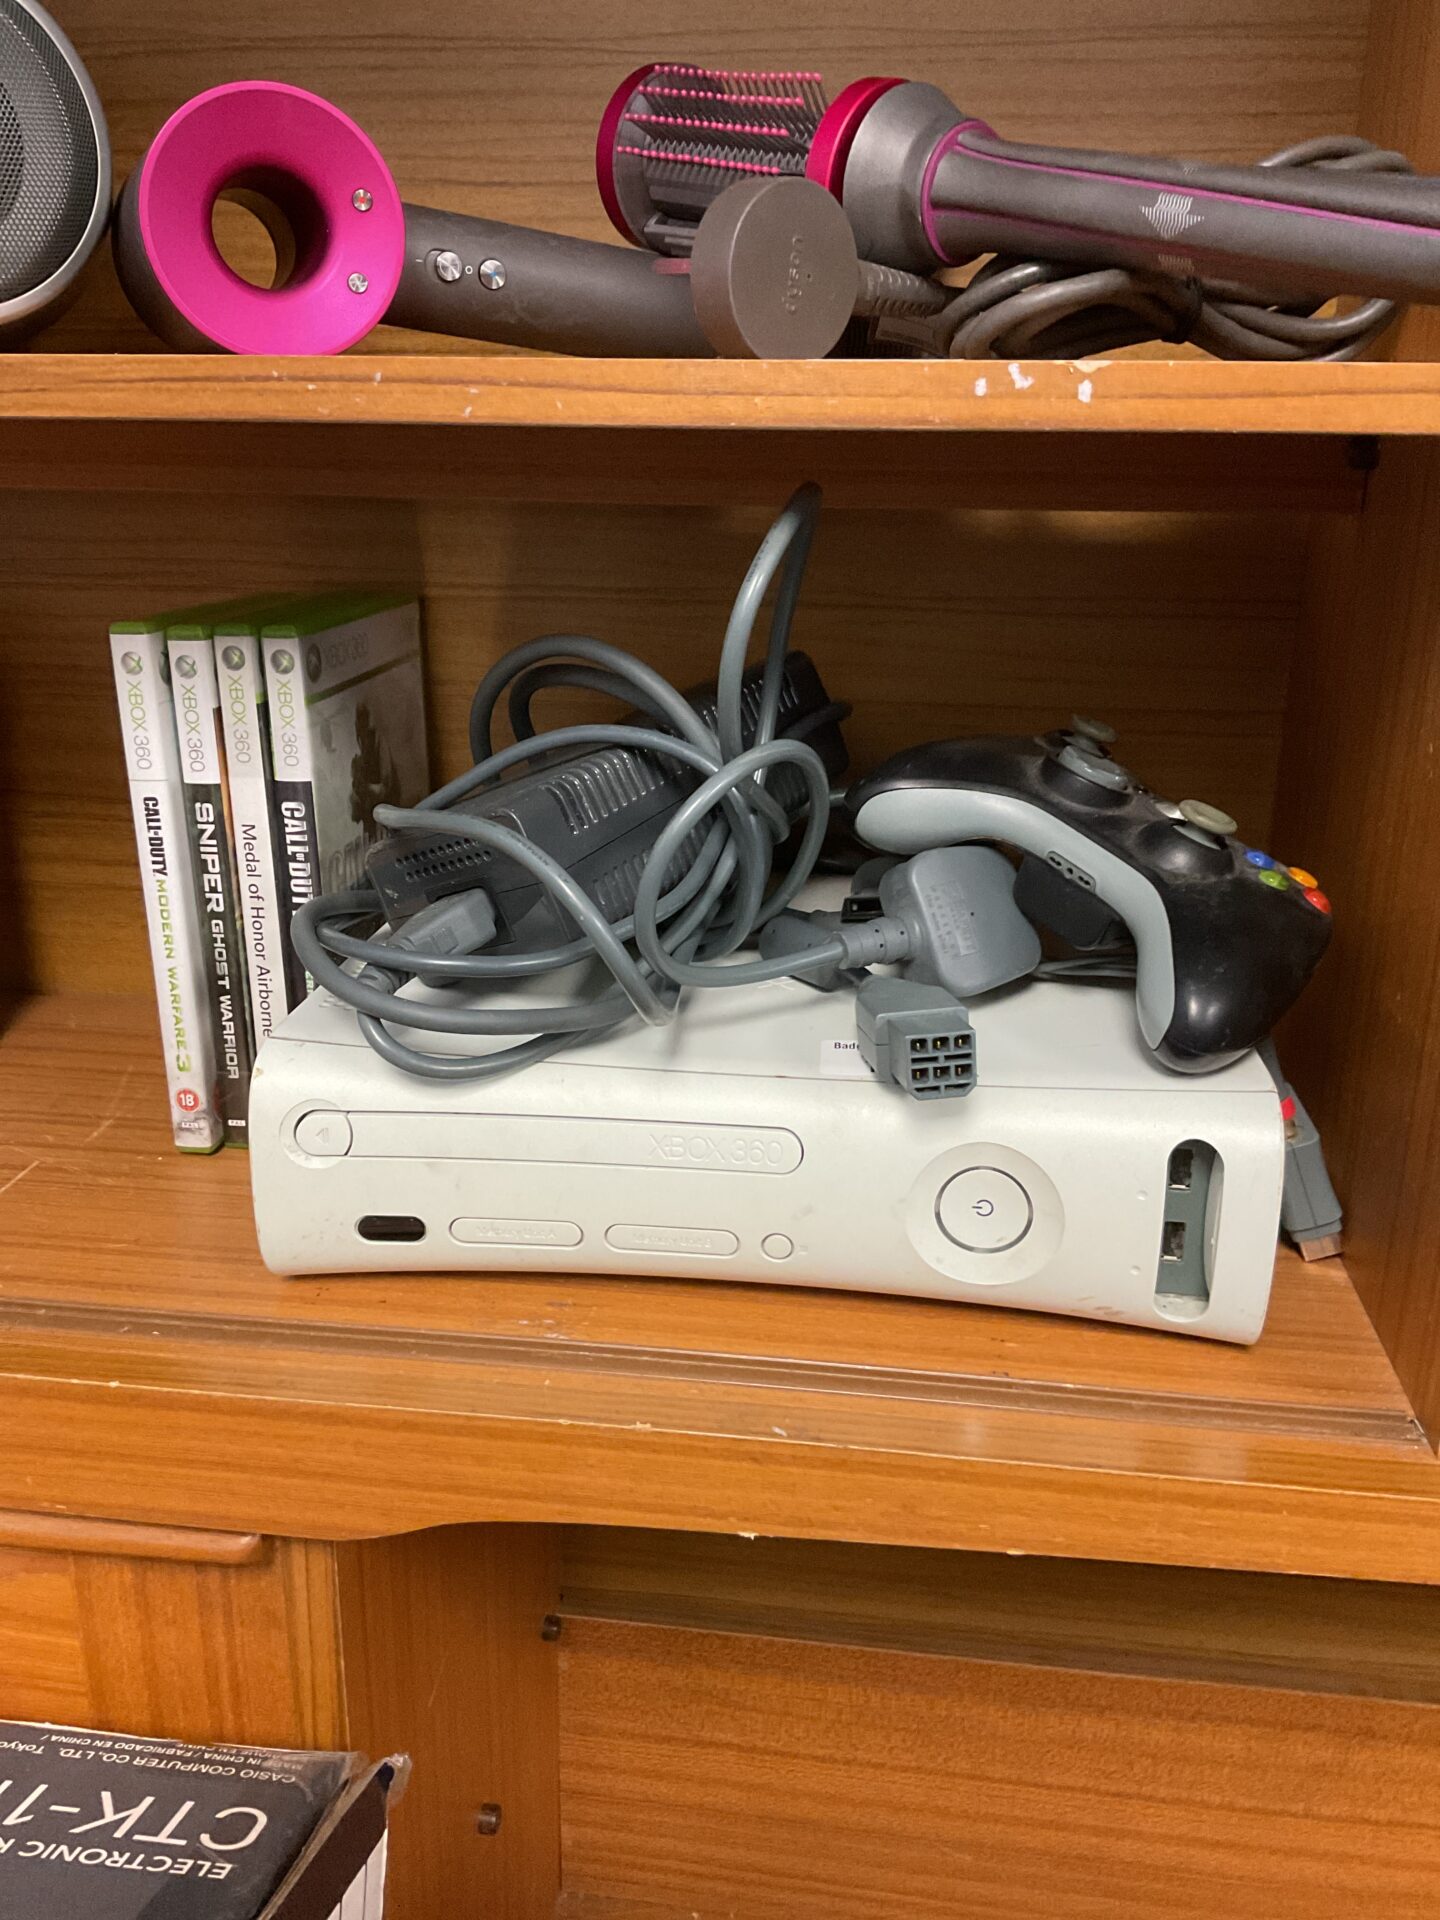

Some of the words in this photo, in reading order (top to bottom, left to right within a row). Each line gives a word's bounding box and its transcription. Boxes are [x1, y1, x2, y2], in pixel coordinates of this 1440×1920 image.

[126, 680, 148, 732] XBOX
[181, 684, 201, 734] XBOX
[228, 675, 247, 726] XBOX
[276, 678, 295, 729] XBOX
[134, 735, 152, 770] 360
[187, 737, 206, 772] 360
[233, 728, 251, 764] 360
[281, 732, 299, 767] 360
[143, 796, 162, 833] CALL
[281, 801, 310, 856] CALL
[149, 836, 169, 877] DUTY
[195, 802, 225, 914] SNIPER
[241, 824, 263, 879] Medal
[248, 882, 264, 903] of
[288, 861, 314, 917] DUT
[156, 879, 174, 959] MODERN
[250, 906, 266, 960] Honor
[211, 919, 230, 989] GHOST
[168, 967, 188, 1049] WARFARE
[256, 965, 273, 1038] Airborne
[218, 995, 239, 1079] WARRIOR
[177, 1054, 192, 1073] 3
[179, 1093, 195, 1107] 18
[648, 1134, 727, 1163] XBOX
[730, 1138, 783, 1167] 360
[50, 1734, 91, 1745] CHINA
[92, 1739, 113, 1748] EN
[114, 1742, 192, 1758] FABRICADO
[203, 1752, 245, 1764] CHINA
[133, 1756, 236, 1776] COMPUTER
[240, 1769, 296, 1783] CASIO
[0, 1780, 267, 1850] CTK-1
[18, 1840, 233, 1880] ELECTRONIC
